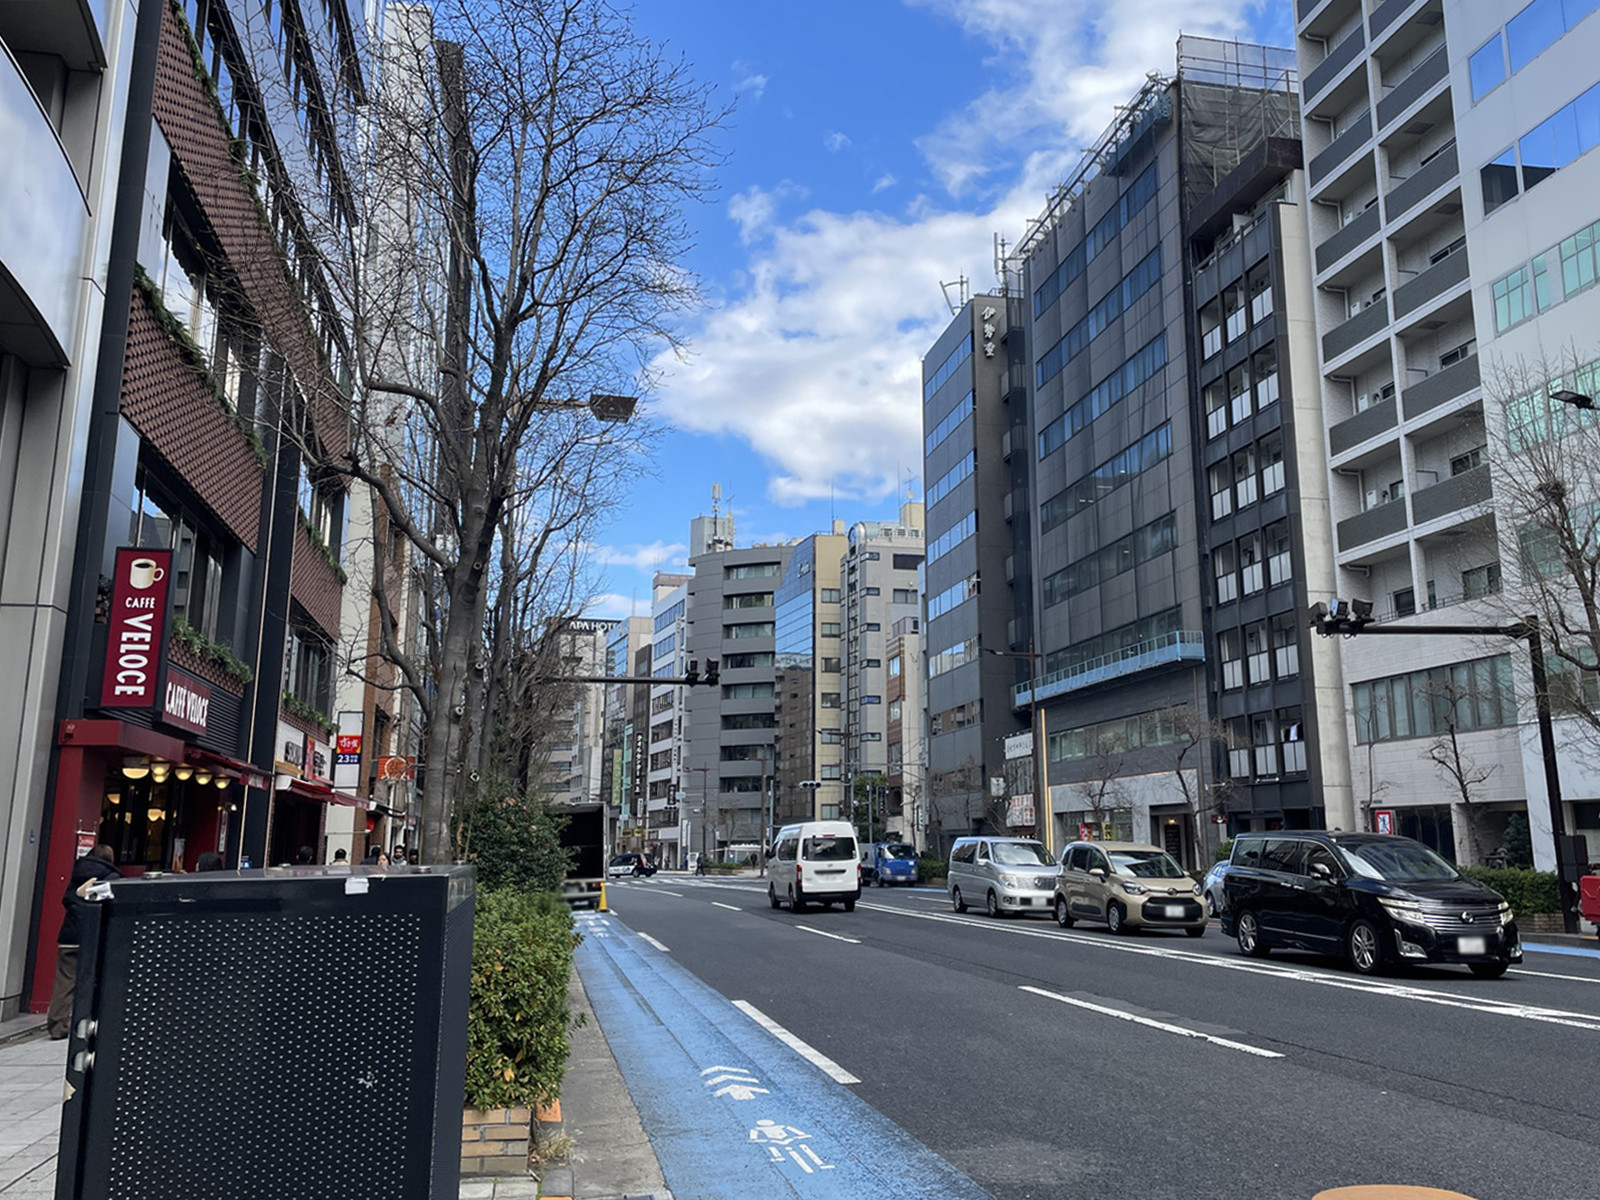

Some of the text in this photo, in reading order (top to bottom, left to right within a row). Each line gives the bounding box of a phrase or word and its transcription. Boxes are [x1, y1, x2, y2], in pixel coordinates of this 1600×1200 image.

[569, 621, 589, 630] APA
[114, 613, 154, 695] VELOCE
[186, 691, 209, 727] VELOCE
